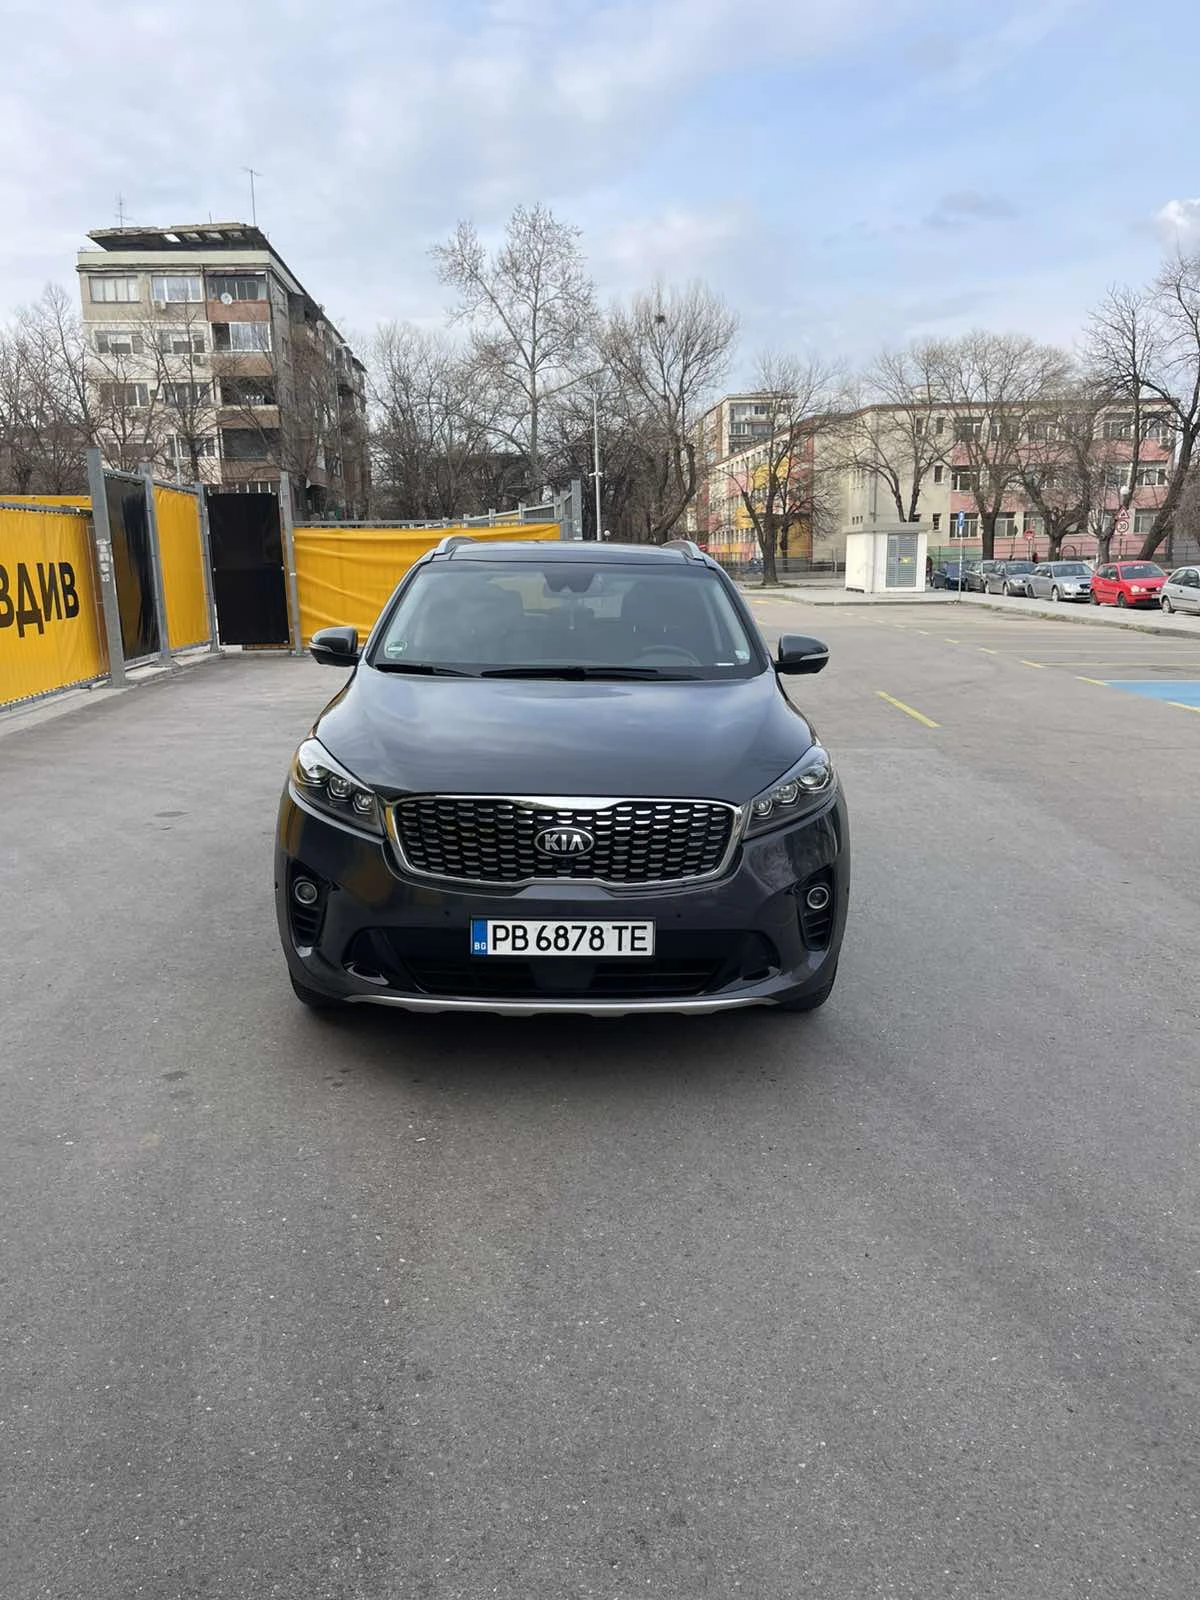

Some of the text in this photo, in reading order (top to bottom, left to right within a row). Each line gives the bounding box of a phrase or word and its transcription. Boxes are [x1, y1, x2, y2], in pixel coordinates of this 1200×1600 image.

[544, 833, 585, 851] KIA
[474, 942, 486, 950] BG
[492, 925, 648, 951] PB 6878 TE
